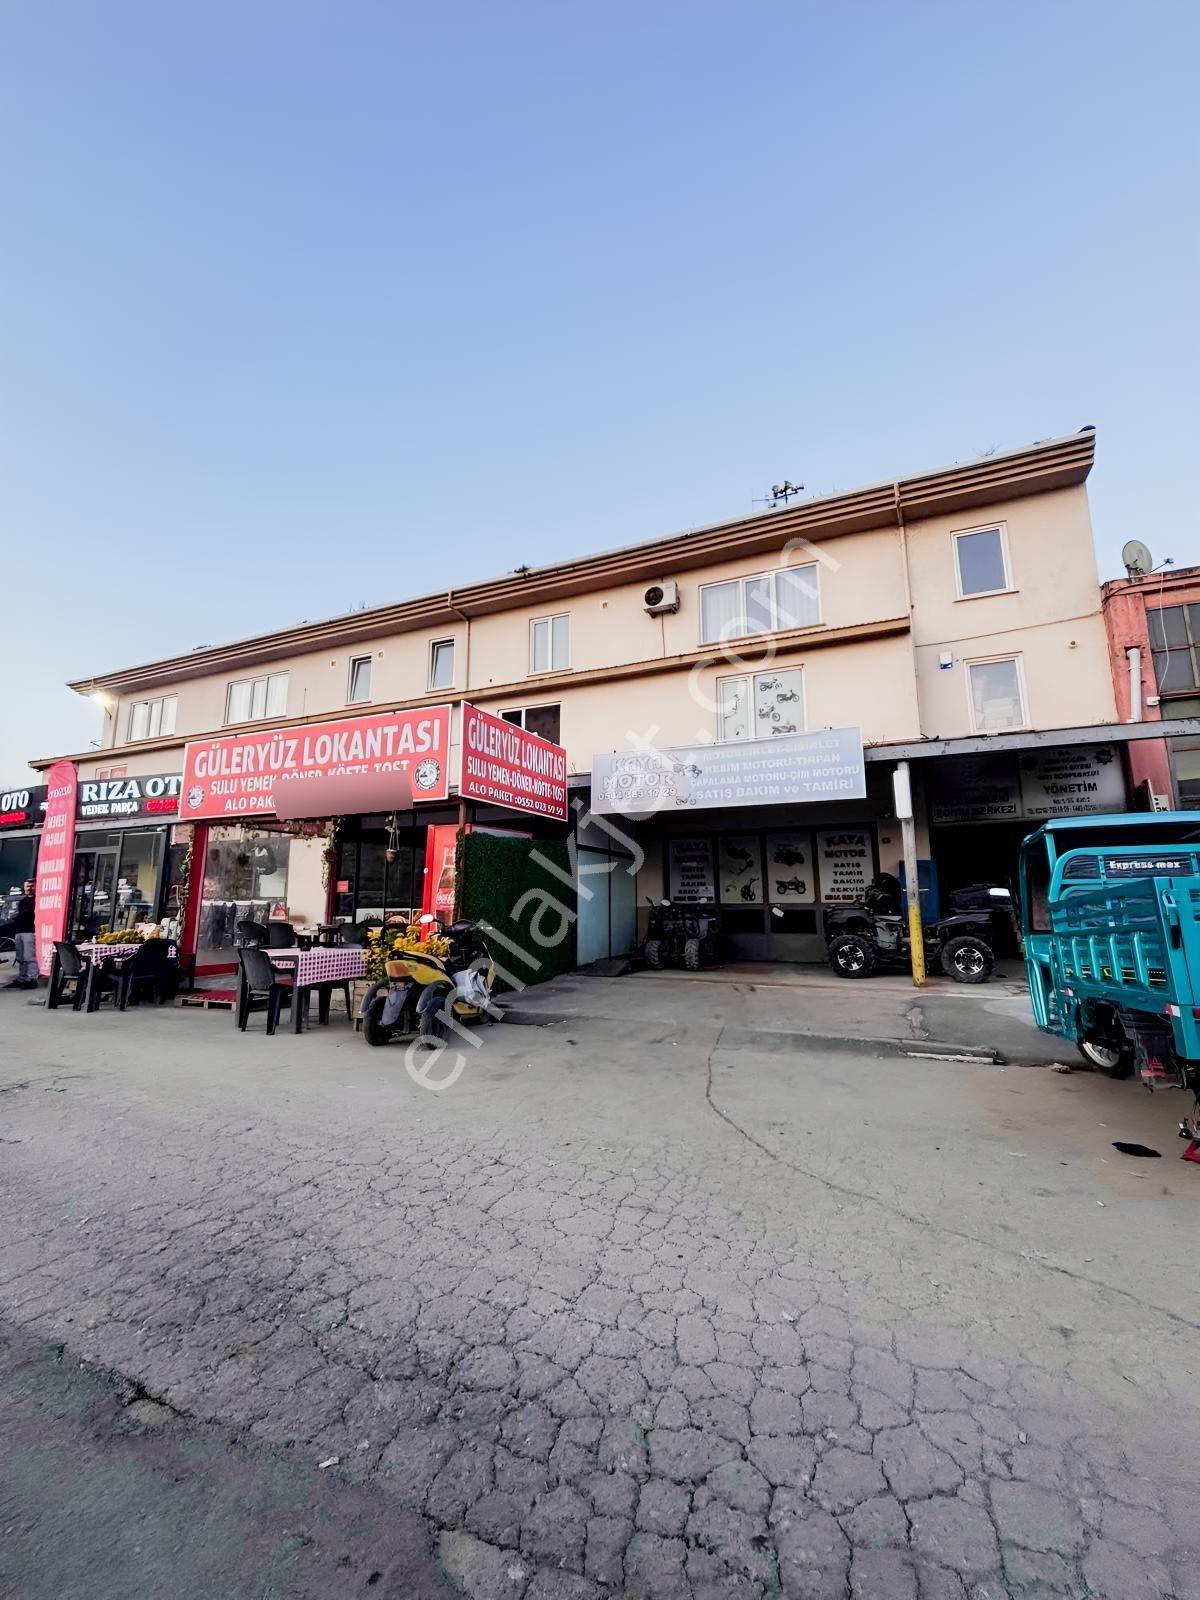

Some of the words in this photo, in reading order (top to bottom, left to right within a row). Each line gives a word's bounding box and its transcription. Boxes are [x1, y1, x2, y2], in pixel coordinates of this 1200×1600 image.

[194, 734, 299, 778] GÜLERYÜZ
[302, 718, 441, 766] LOKANTASI
[468, 713, 520, 766] GÜLERYÜZ
[521, 740, 566, 783] LOKANTASI
[467, 756, 487, 779] SULU
[813, 765, 860, 778] MOTORU
[82, 780, 142, 802] RIZA
[145, 775, 183, 797] OT
[210, 778, 238, 796] SULU
[602, 771, 677, 790] MOTOR
[695, 787, 733, 800] SATIŞ
[736, 784, 780, 798] BAKIM
[784, 785, 800, 794] ve
[802, 776, 854, 793] TAMİRİ
[1043, 780, 1098, 794] YÖNETİM
[1, 790, 30, 812] OTO
[468, 782, 487, 795] ALO
[488, 787, 514, 803] PAKET
[662, 787, 678, 798] 29
[82, 801, 109, 816] YEDEK
[110, 800, 139, 816] PARÇA
[224, 797, 247, 811] ALO
[249, 795, 275, 809] PAK
[825, 834, 866, 848] KAYA
[824, 849, 867, 858] MOTOR
[1109, 860, 1153, 870] Express
